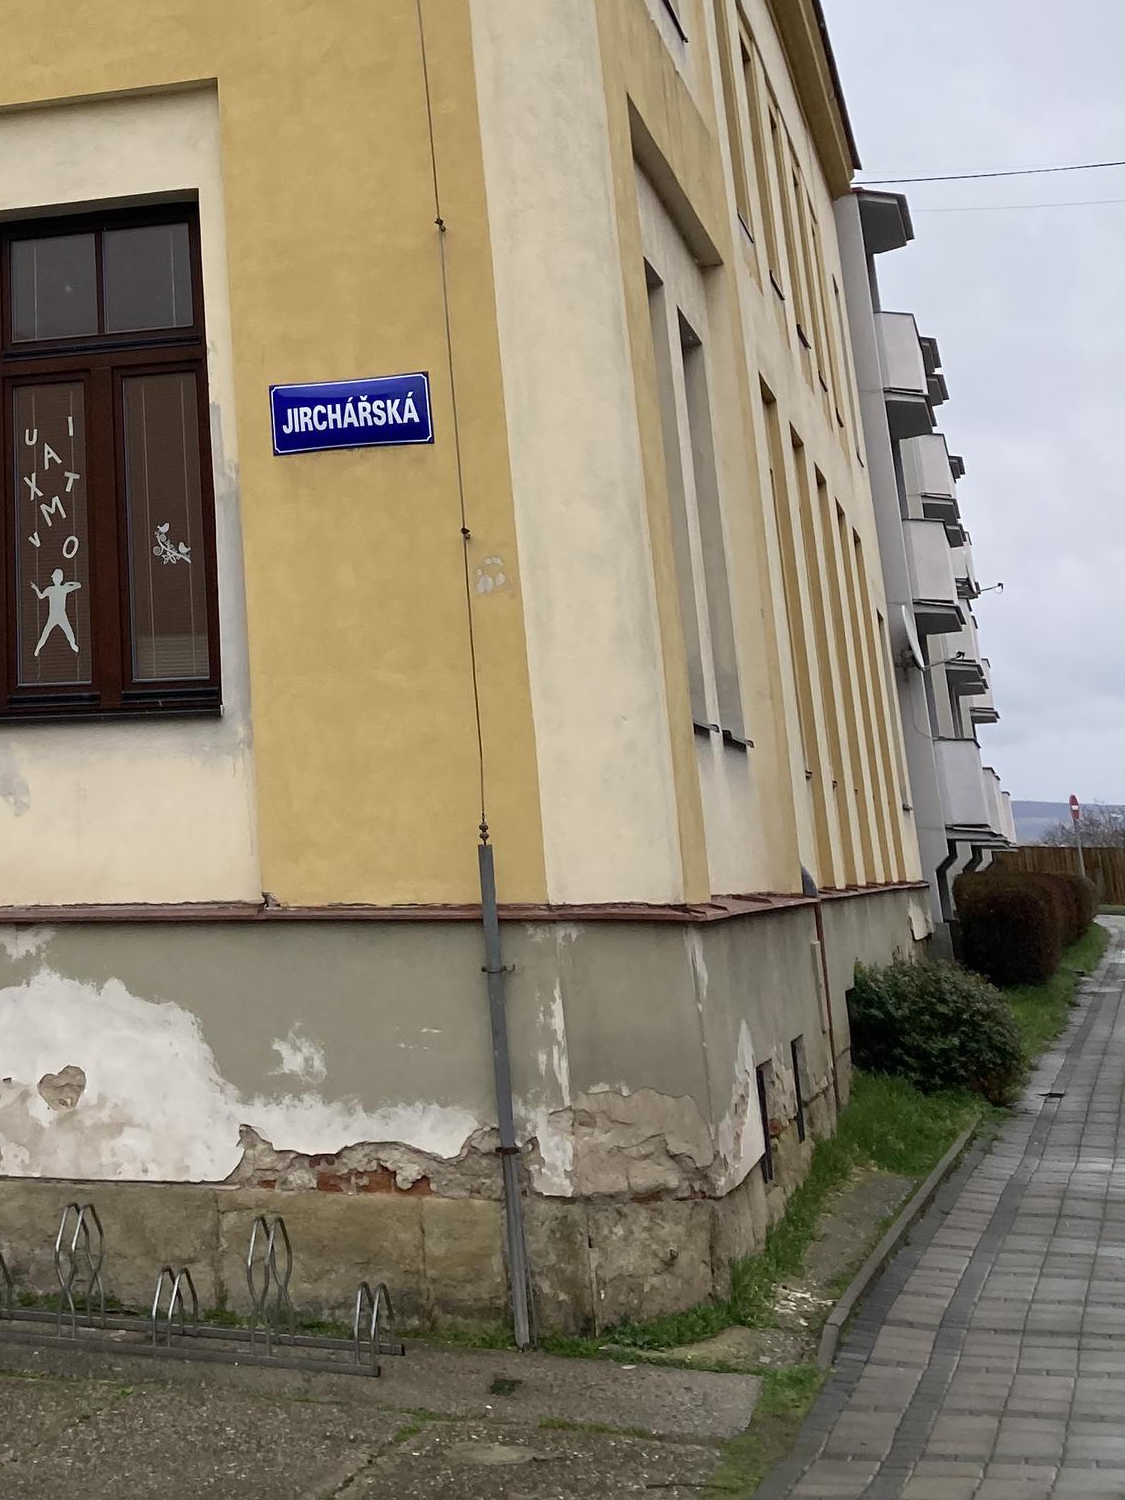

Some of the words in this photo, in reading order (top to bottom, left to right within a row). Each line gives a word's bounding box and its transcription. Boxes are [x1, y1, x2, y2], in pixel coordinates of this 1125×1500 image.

[282, 391, 420, 434] JIRCHÁŘSKÁ
[24, 428, 38, 446] U
[43, 442, 63, 470] A
[23, 472, 44, 501] X
[64, 471, 81, 493] T
[39, 495, 67, 527] M
[62, 534, 80, 559] O
